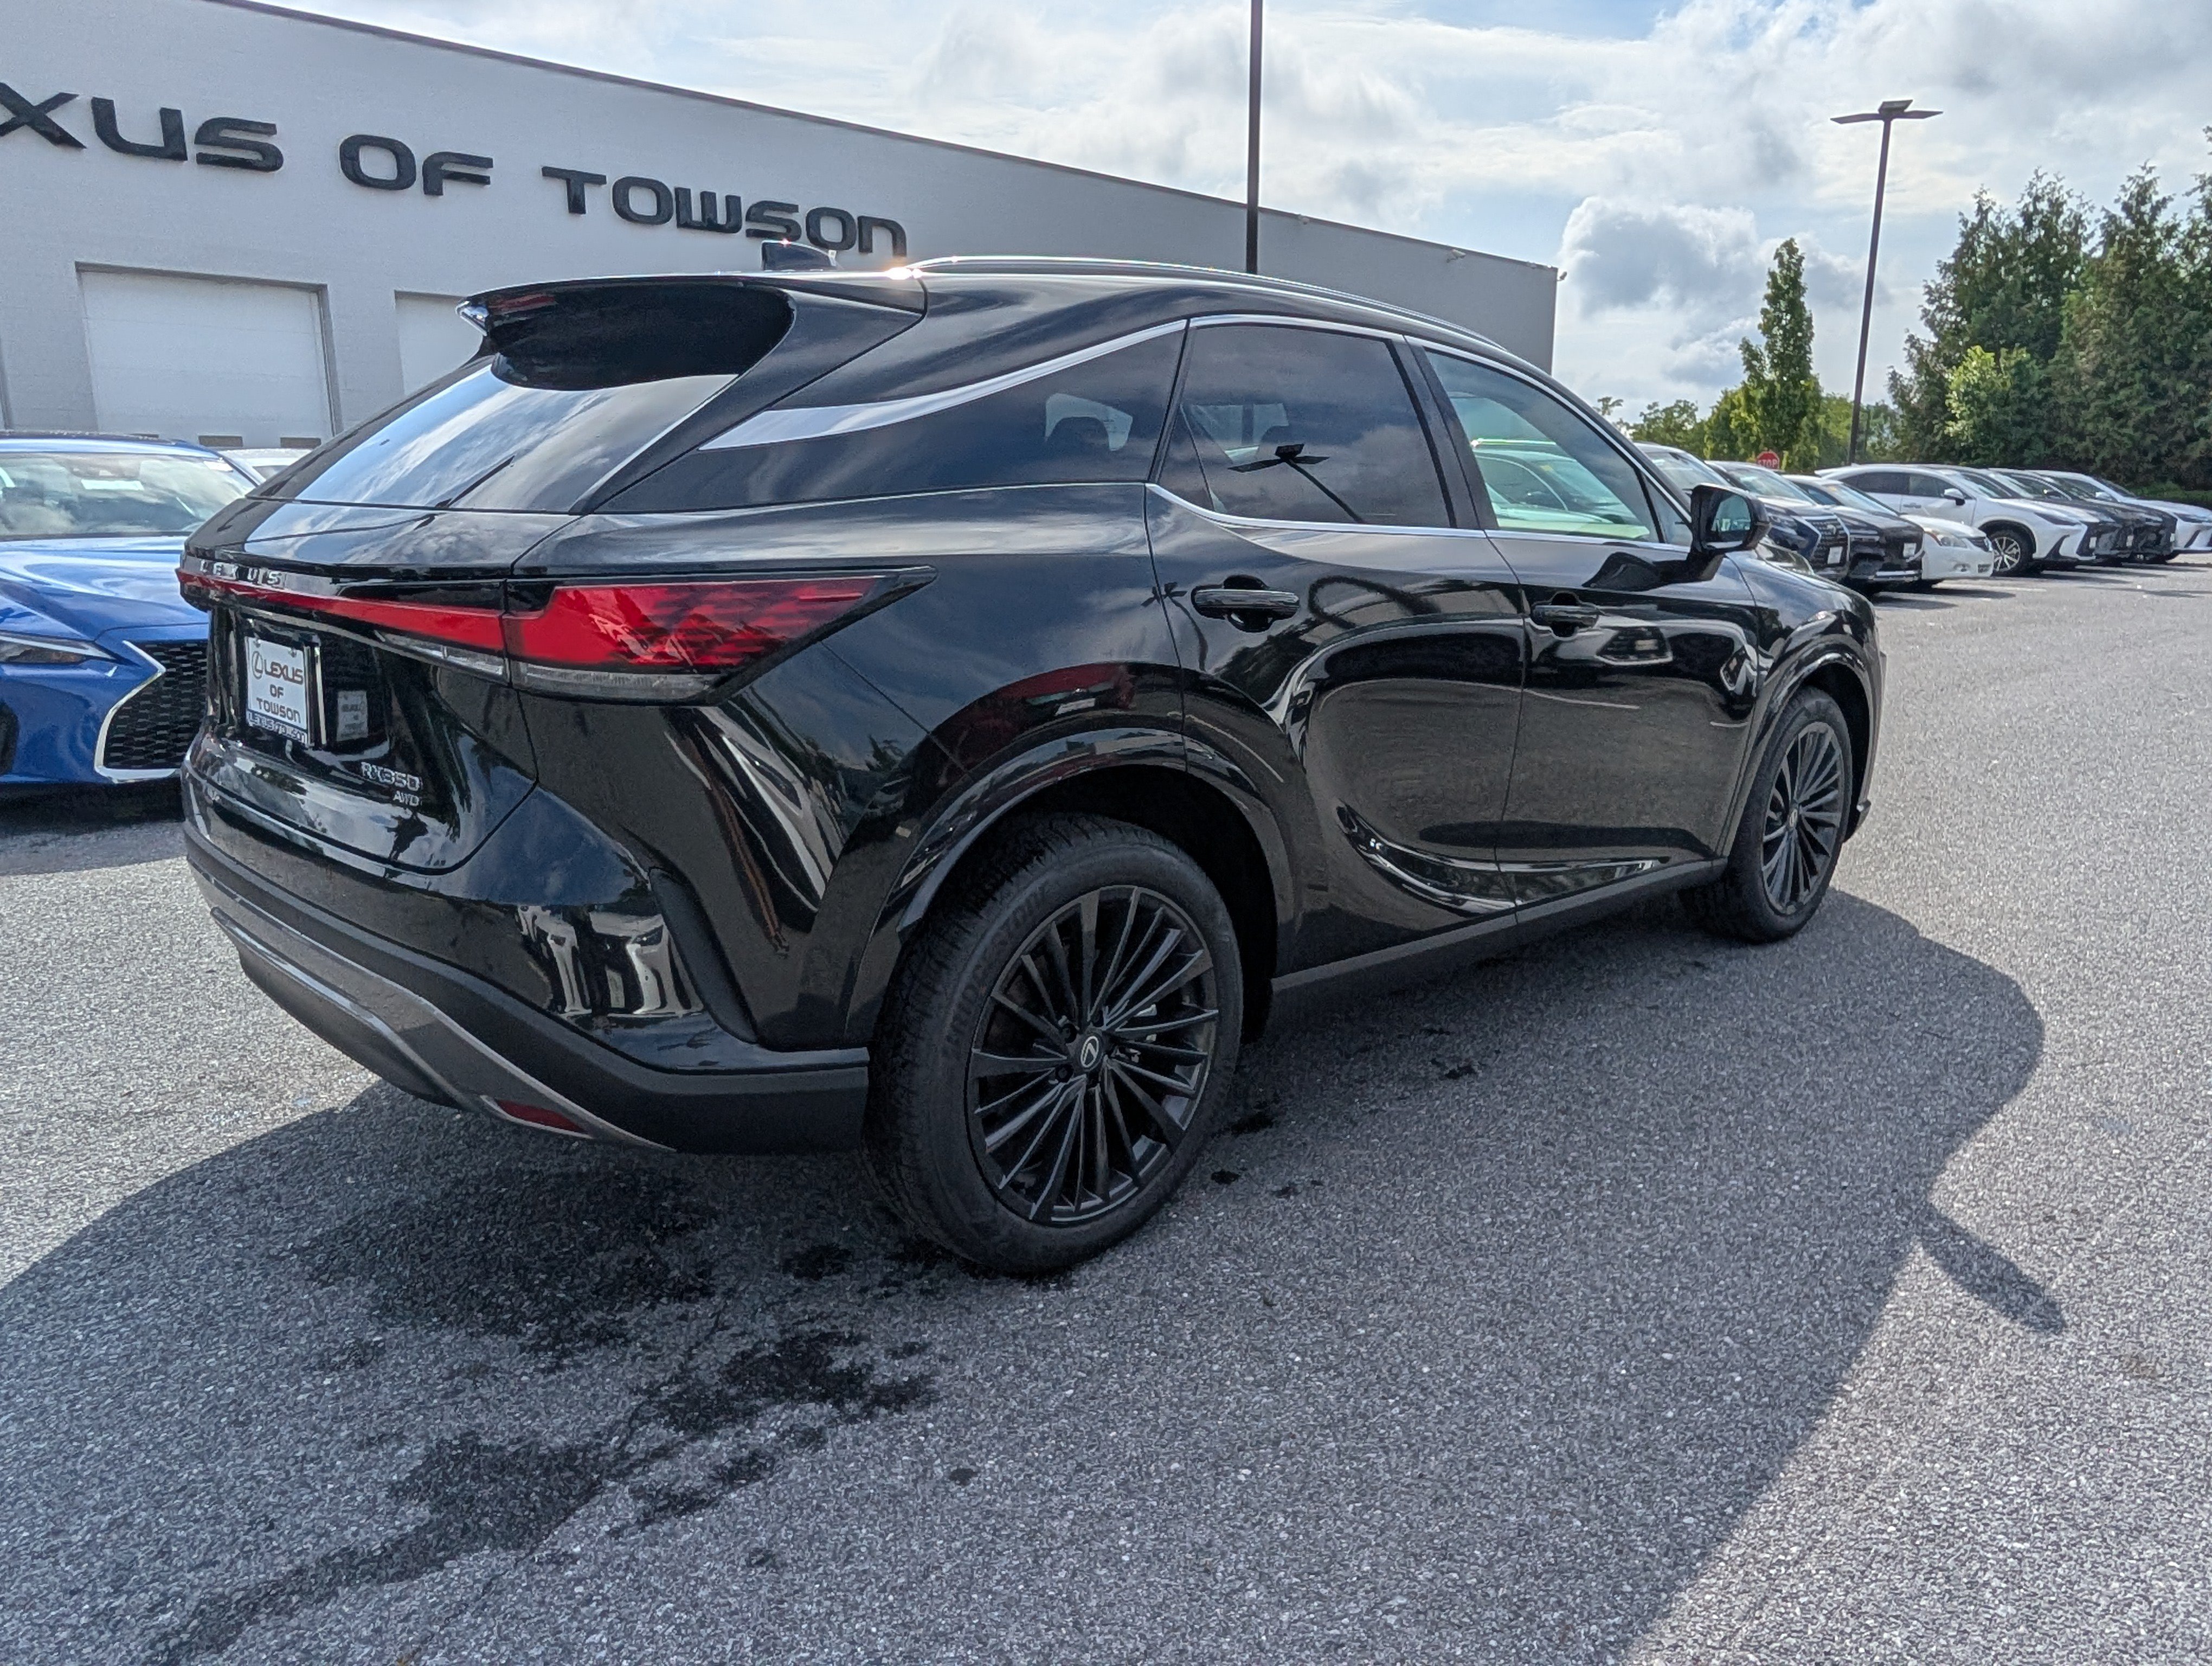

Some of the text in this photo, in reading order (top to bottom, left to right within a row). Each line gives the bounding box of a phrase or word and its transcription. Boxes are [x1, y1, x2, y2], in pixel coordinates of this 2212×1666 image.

[339, 134, 493, 196] OF
[541, 166, 908, 258] TOWSON
[1757, 459, 1778, 468] STOP
[263, 658, 304, 685] LEXUS
[269, 683, 285, 699] OF
[256, 697, 302, 724] TOWSON
